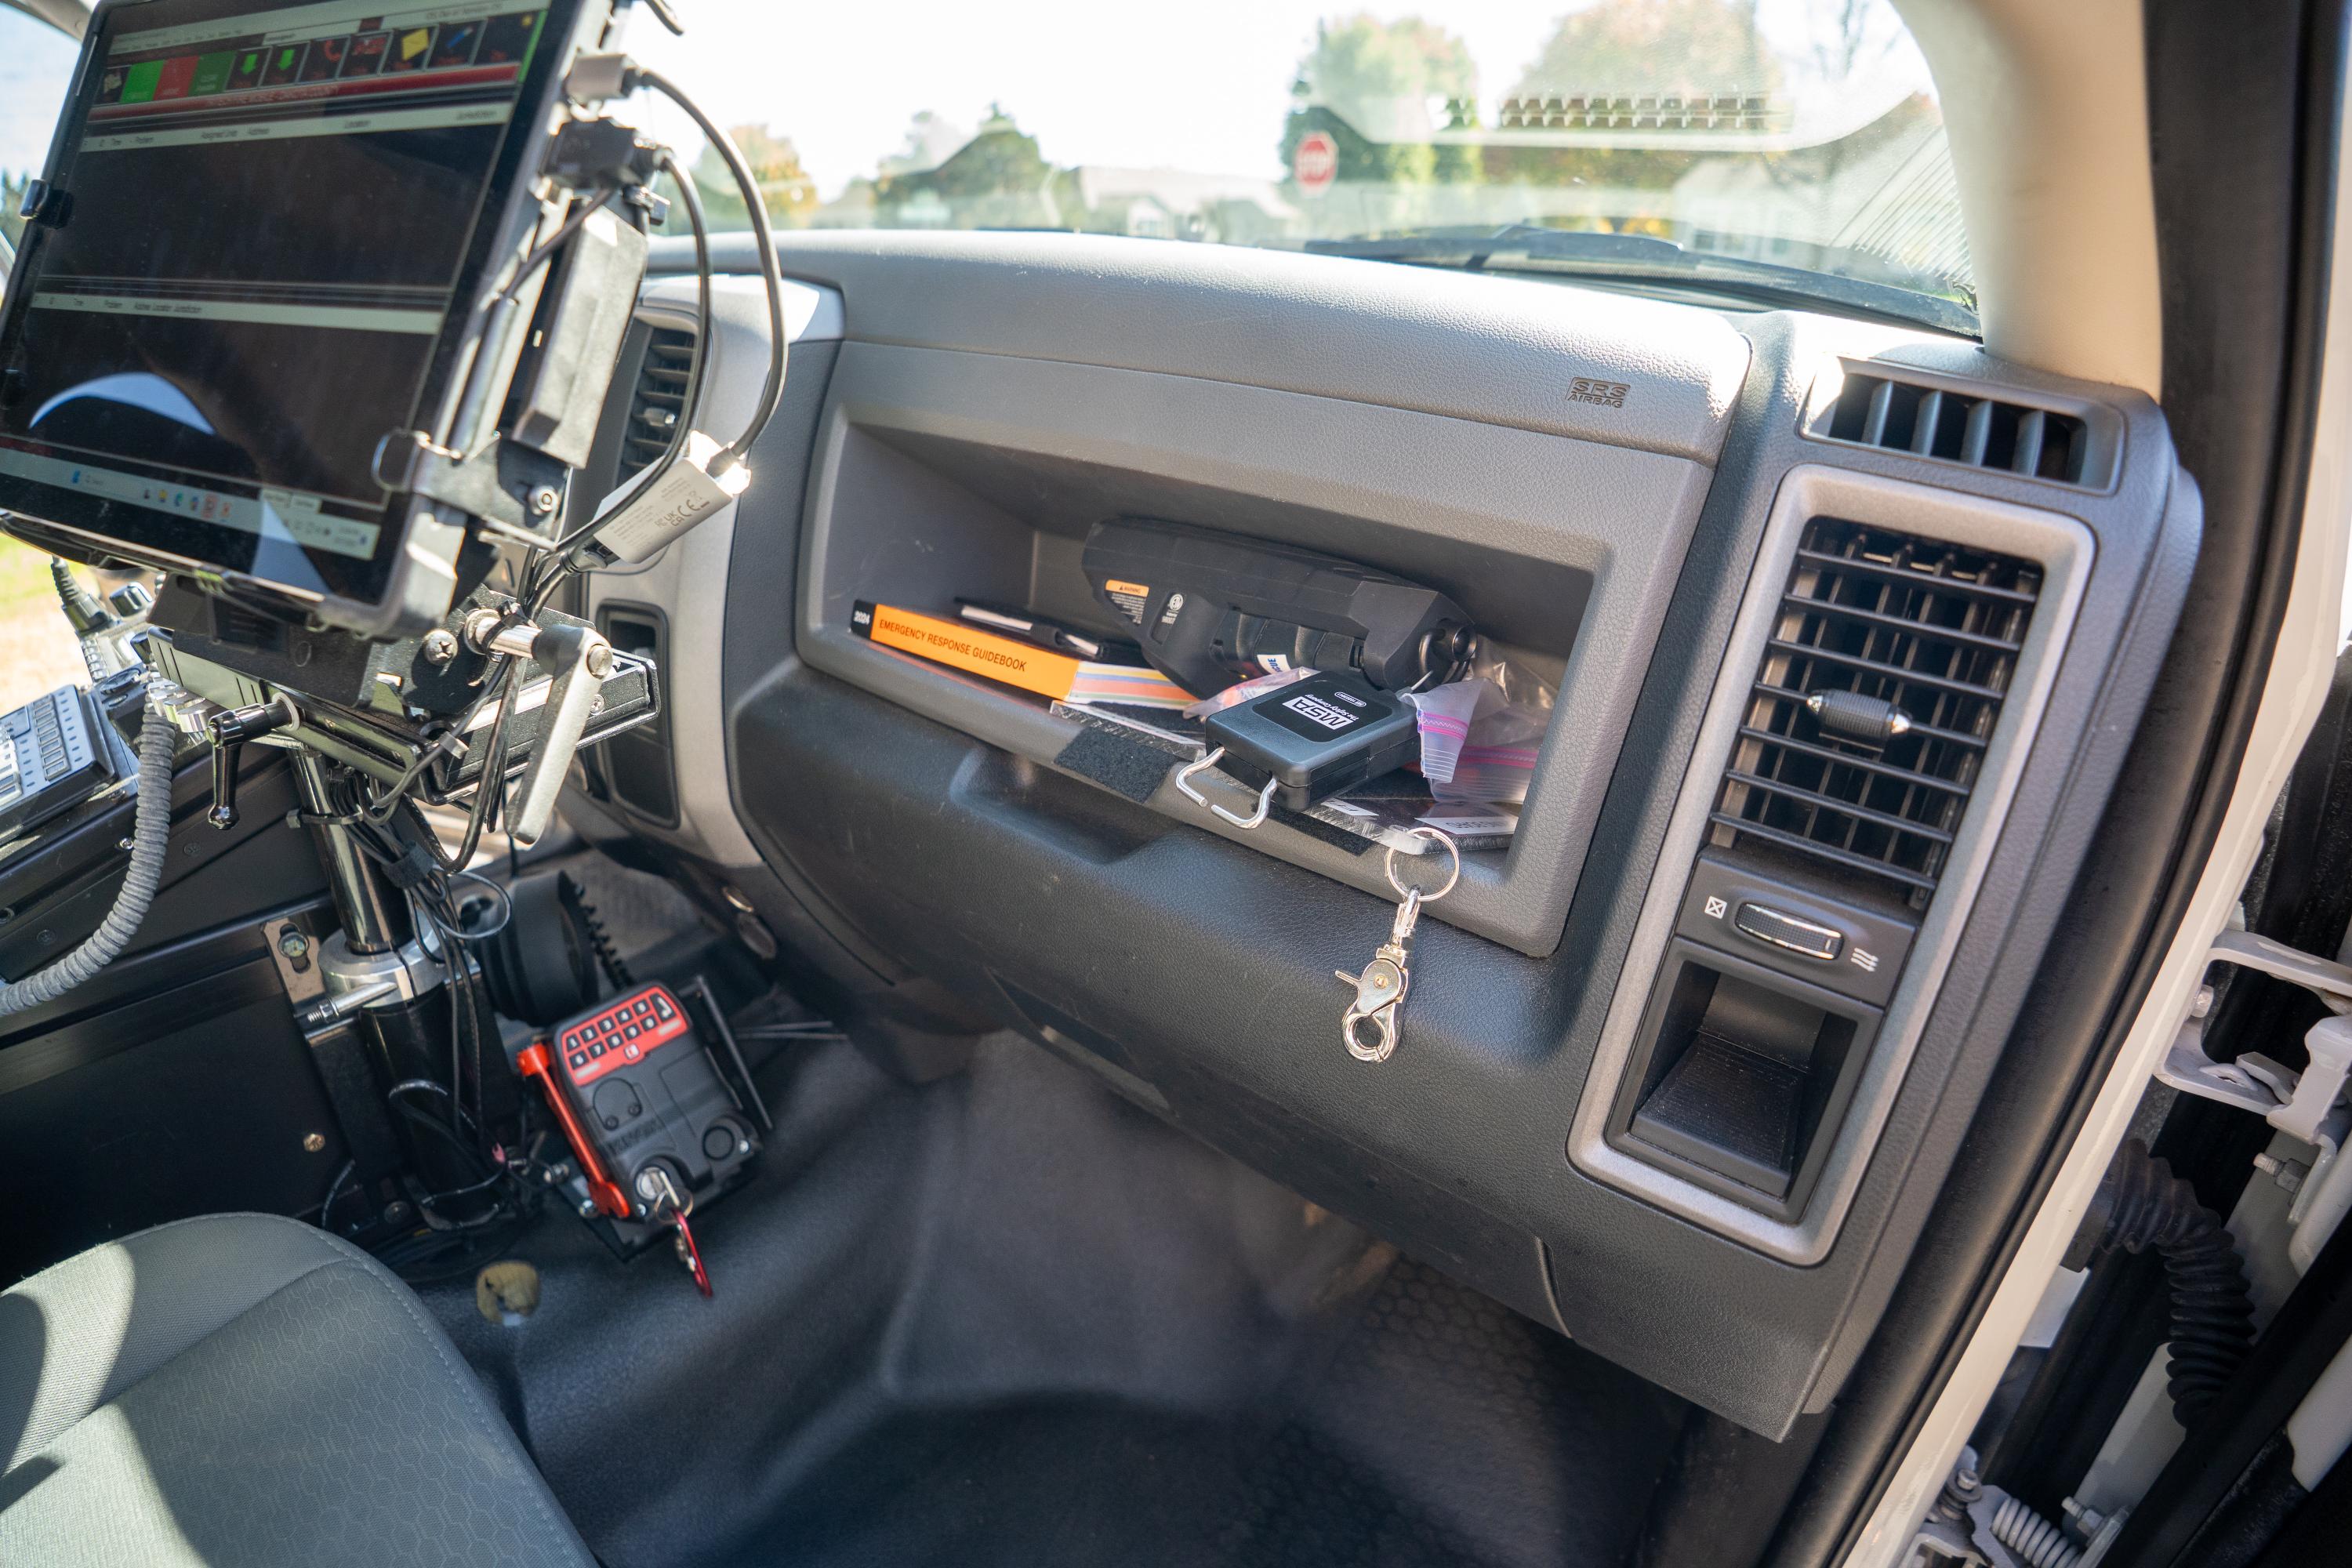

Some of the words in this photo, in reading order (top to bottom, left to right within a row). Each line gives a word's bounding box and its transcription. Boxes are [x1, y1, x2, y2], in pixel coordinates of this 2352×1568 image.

[1572, 381, 1628, 397] SRS
[1567, 394, 1623, 408] AIRBAG
[663, 510, 677, 521] UK
[670, 516, 685, 527] CA
[879, 619, 927, 641] EMERGENCY
[927, 633, 972, 655] RESPONSE
[972, 647, 1028, 672] GUIDEBOOK
[1304, 694, 1331, 708] Company
[1291, 699, 1347, 727] MSA
[1330, 705, 1349, 717] Safety
[1347, 713, 1359, 721] The
